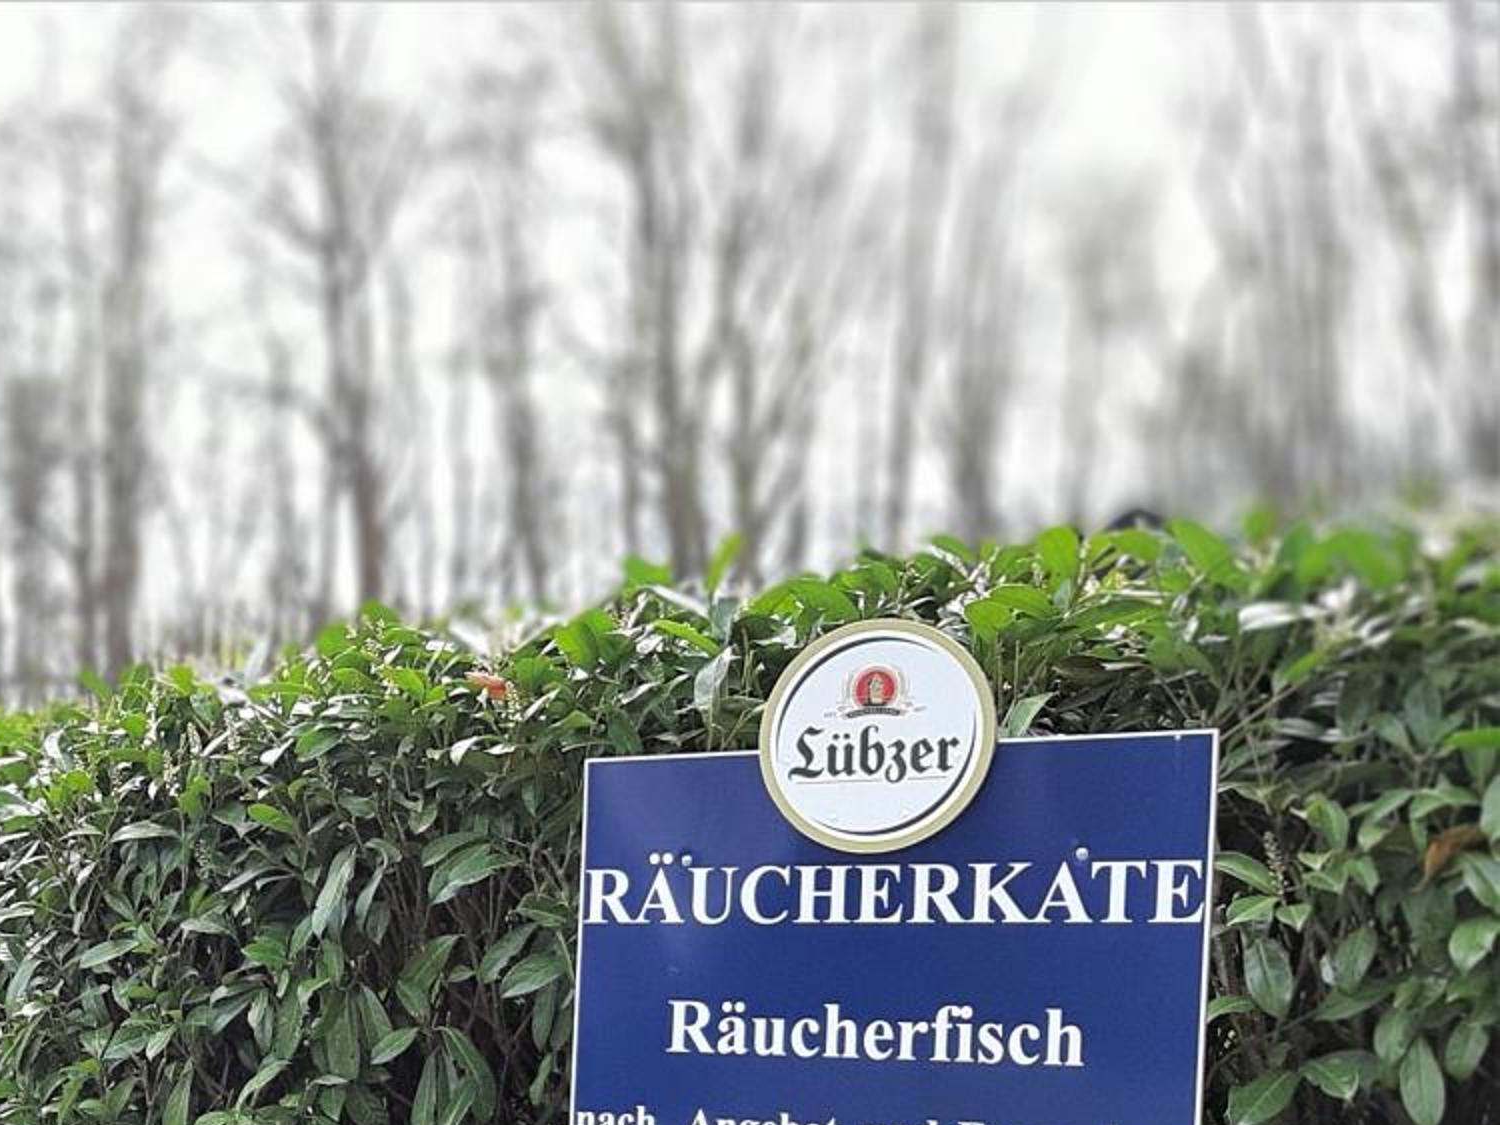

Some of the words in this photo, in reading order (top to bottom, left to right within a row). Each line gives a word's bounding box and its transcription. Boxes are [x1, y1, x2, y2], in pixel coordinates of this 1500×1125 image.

[788, 724, 961, 784] Lübzer
[583, 853, 1205, 926] RÄUCHERKATE
[667, 1001, 1083, 1066] Räucherfisch
